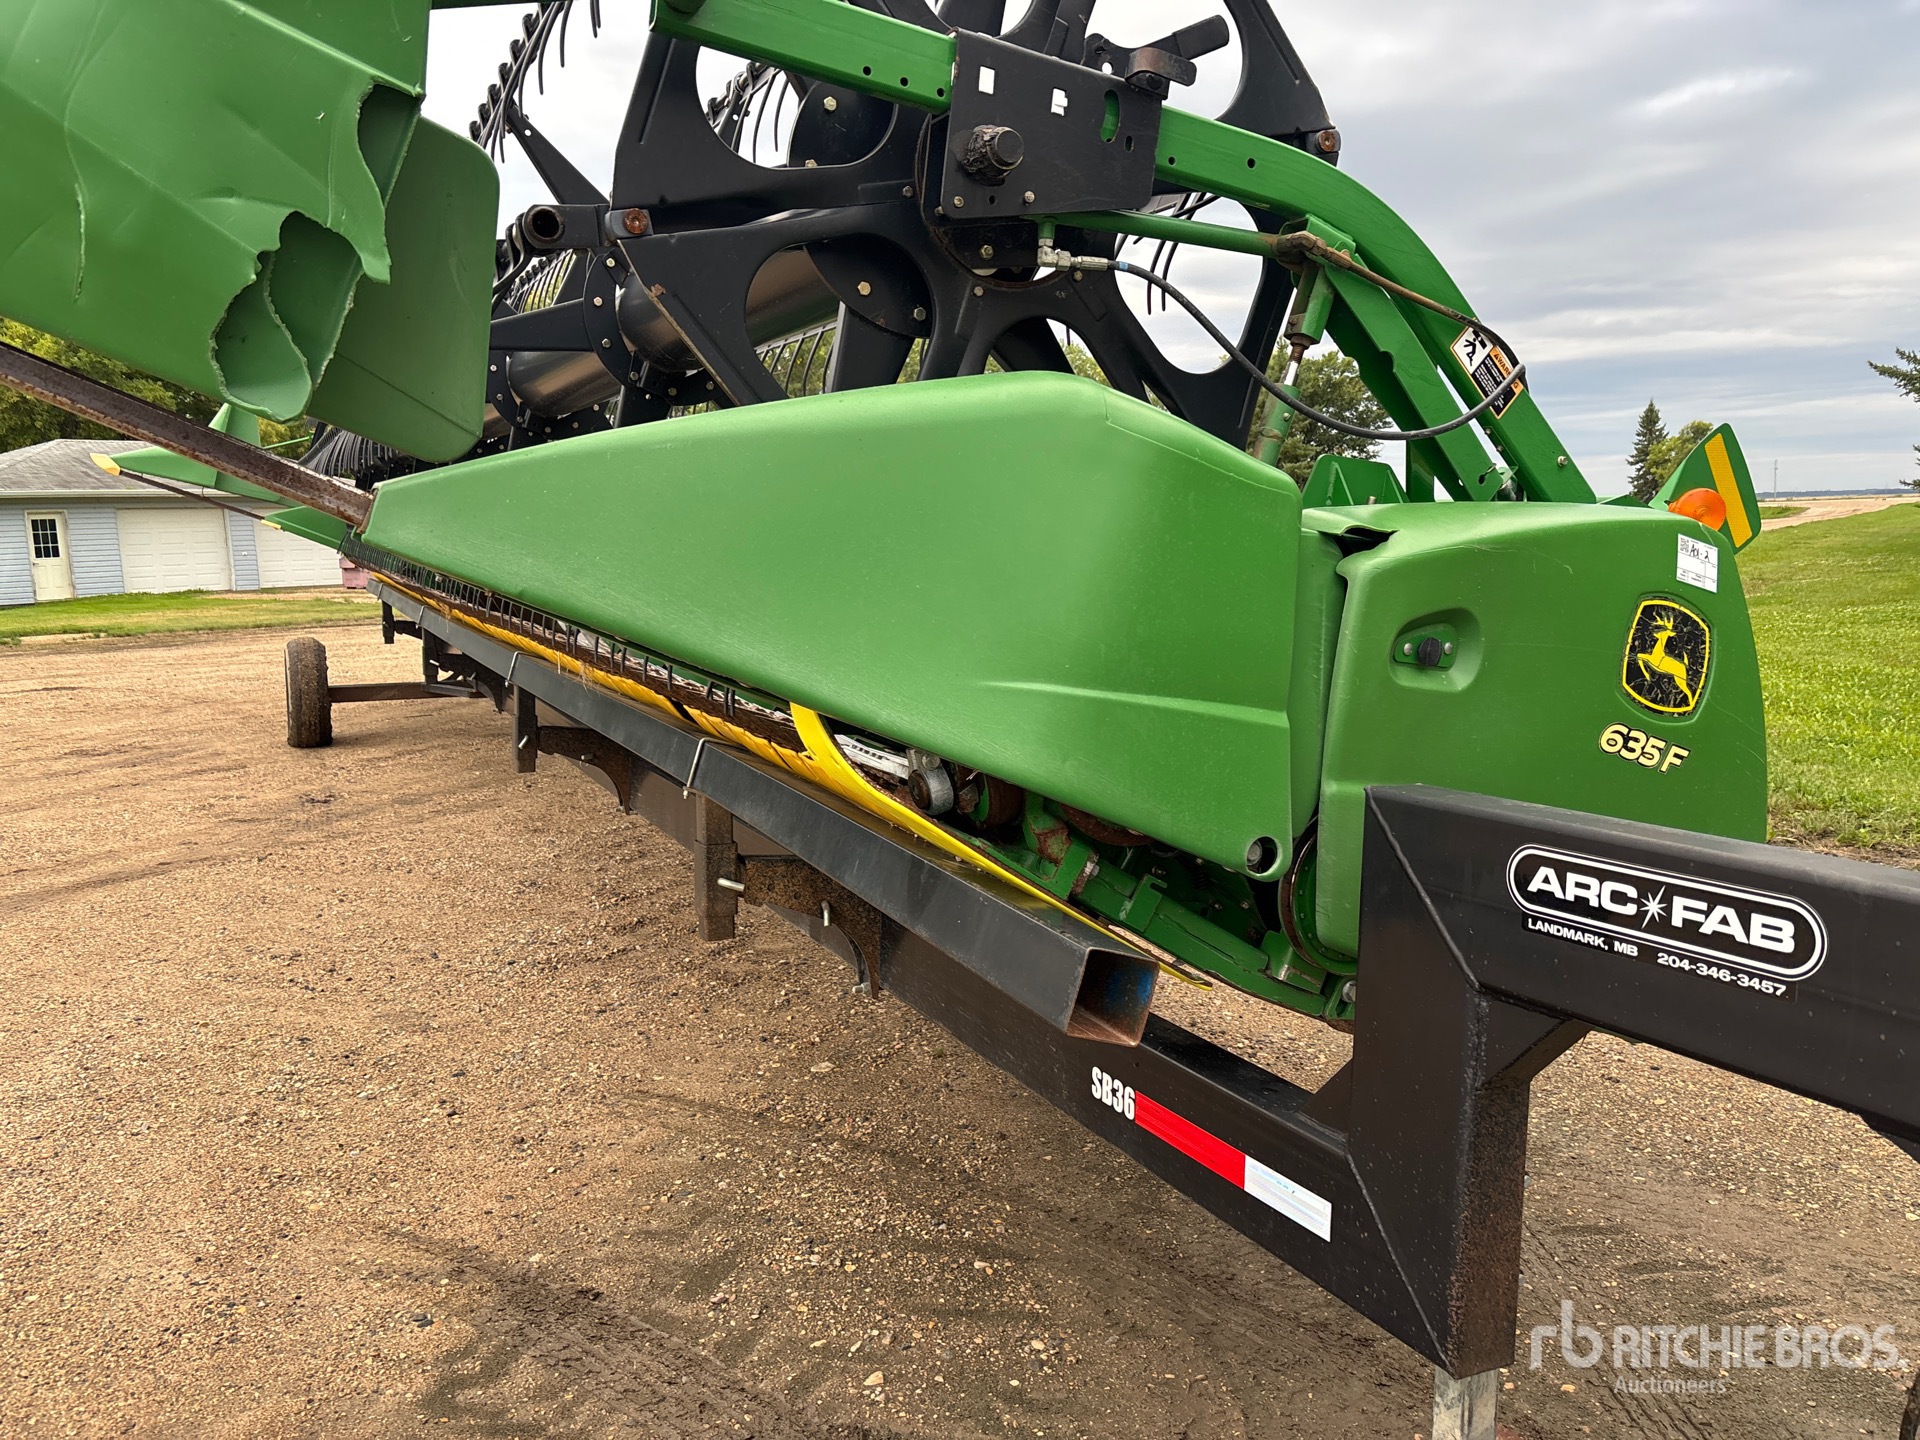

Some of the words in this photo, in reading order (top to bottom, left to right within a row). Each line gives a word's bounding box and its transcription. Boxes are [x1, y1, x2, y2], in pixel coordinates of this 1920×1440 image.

[1497, 356, 1519, 389] WARG
[1599, 722, 1691, 774] 635F
[1527, 866, 1638, 916] ARC
[1671, 895, 1796, 954] FAB
[1528, 918, 1609, 951] LANDMARK,
[1613, 940, 1639, 957] MB
[1657, 952, 1787, 998] 204-346-3457
[1091, 1066, 1136, 1121] SB36
